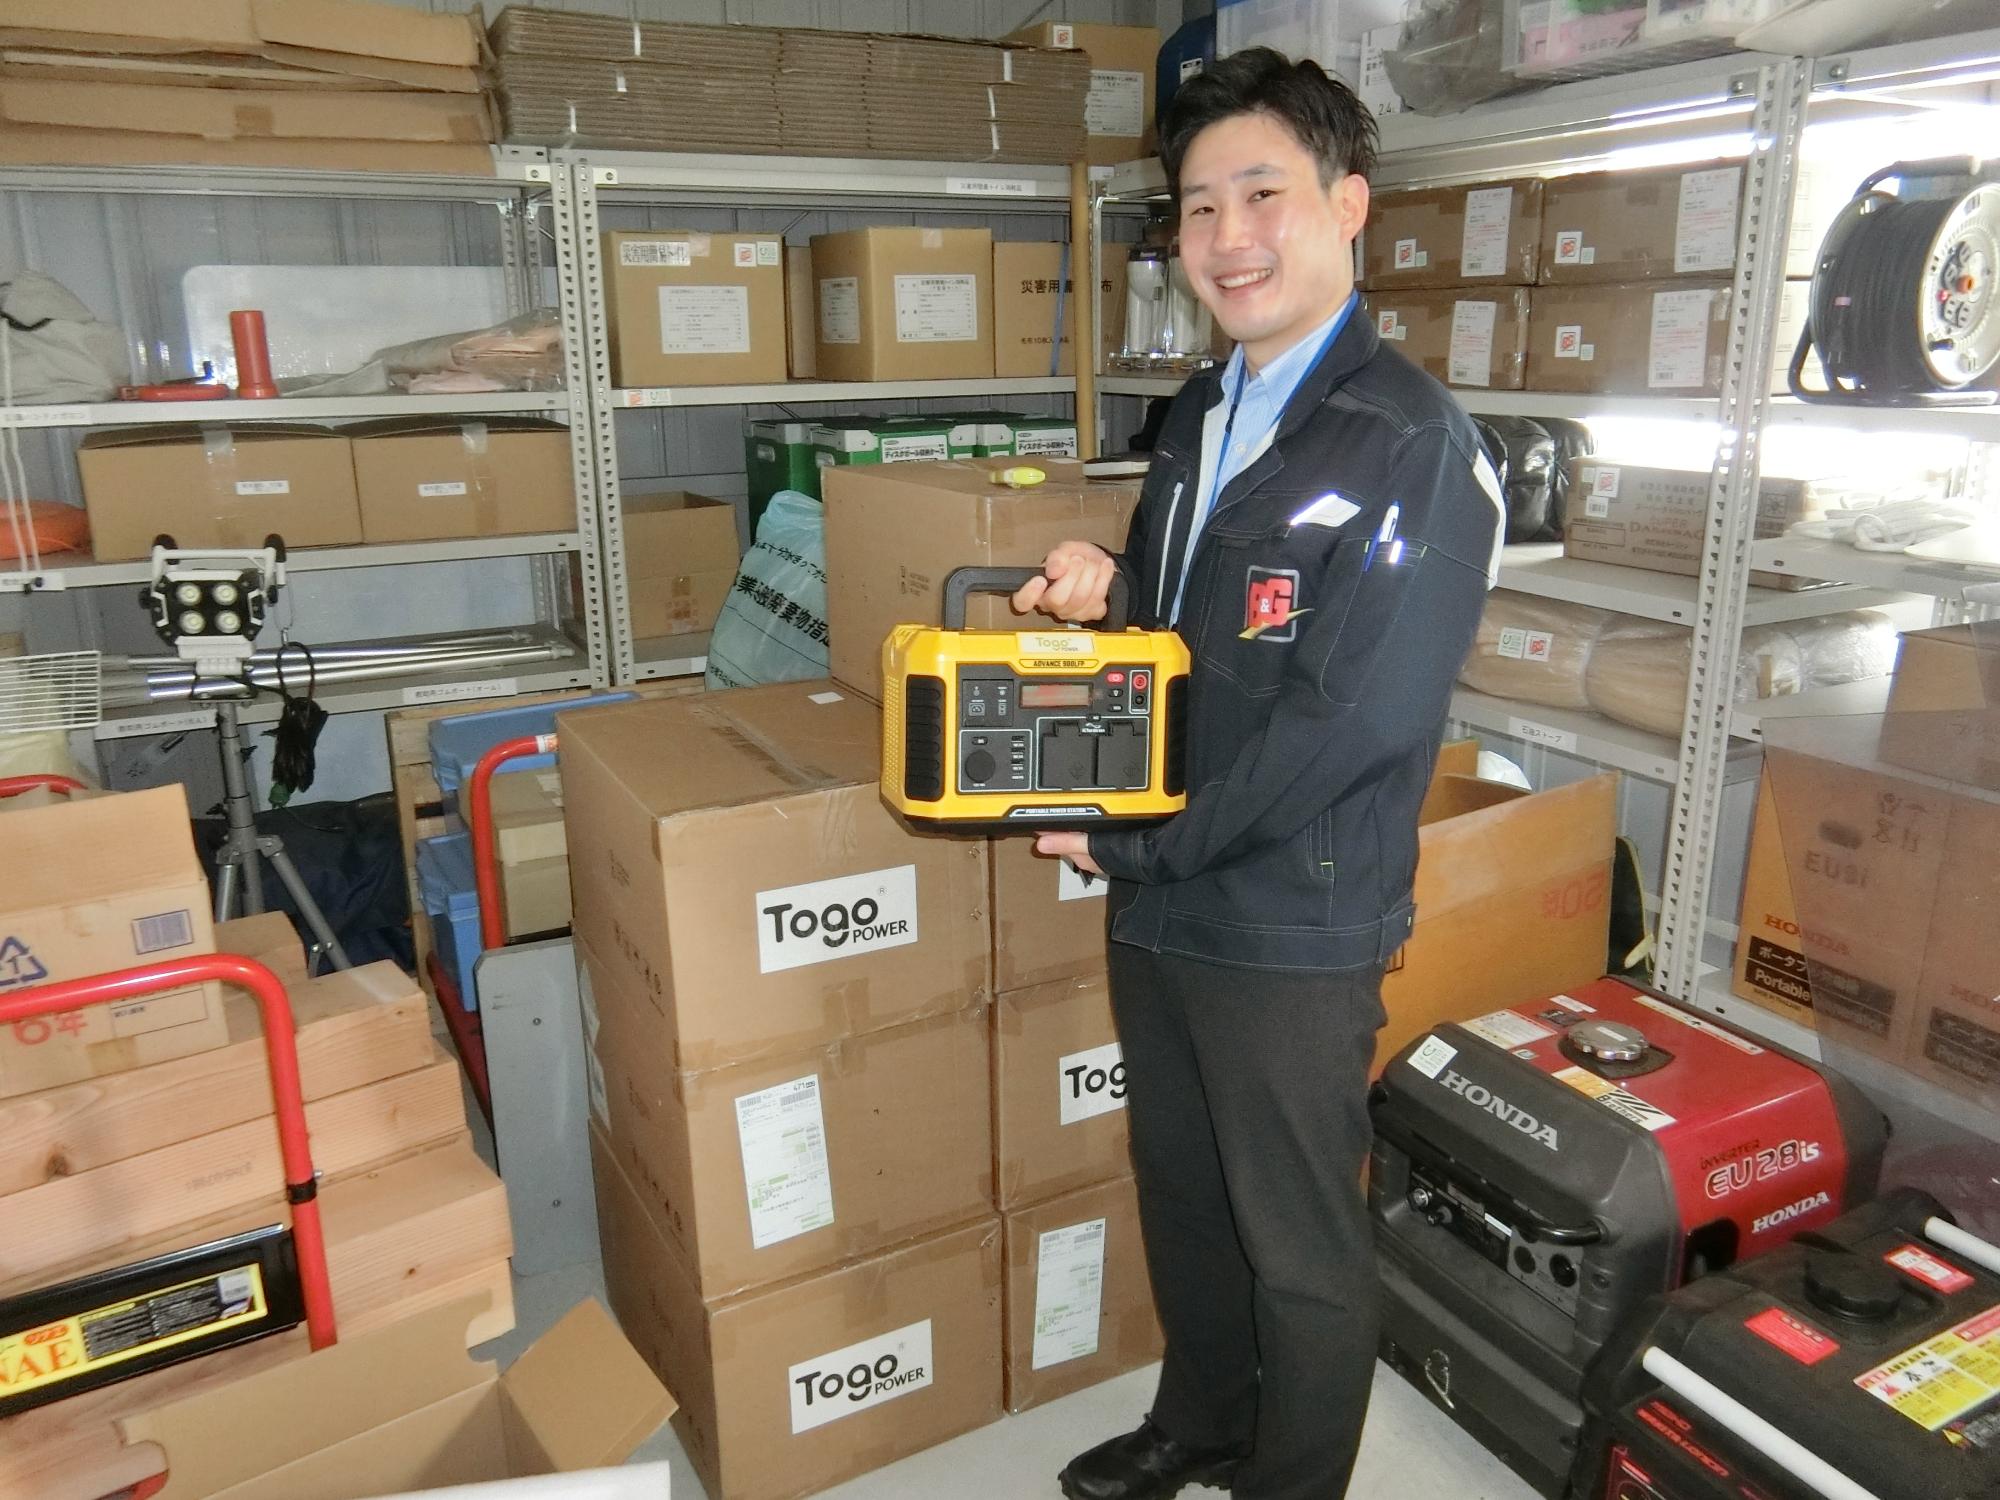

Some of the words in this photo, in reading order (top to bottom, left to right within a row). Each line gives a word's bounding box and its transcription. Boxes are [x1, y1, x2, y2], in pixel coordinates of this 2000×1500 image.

[763, 897, 879, 948] Togo
[853, 919, 909, 944] POWER
[1763, 912, 1850, 955] HONDA
[1754, 968, 1812, 1002] Portable
[1439, 1070, 1559, 1151] HONDA
[1752, 1191, 1830, 1234] HONDA
[795, 1354, 899, 1406] Togo
[875, 1366, 925, 1395] POWER
